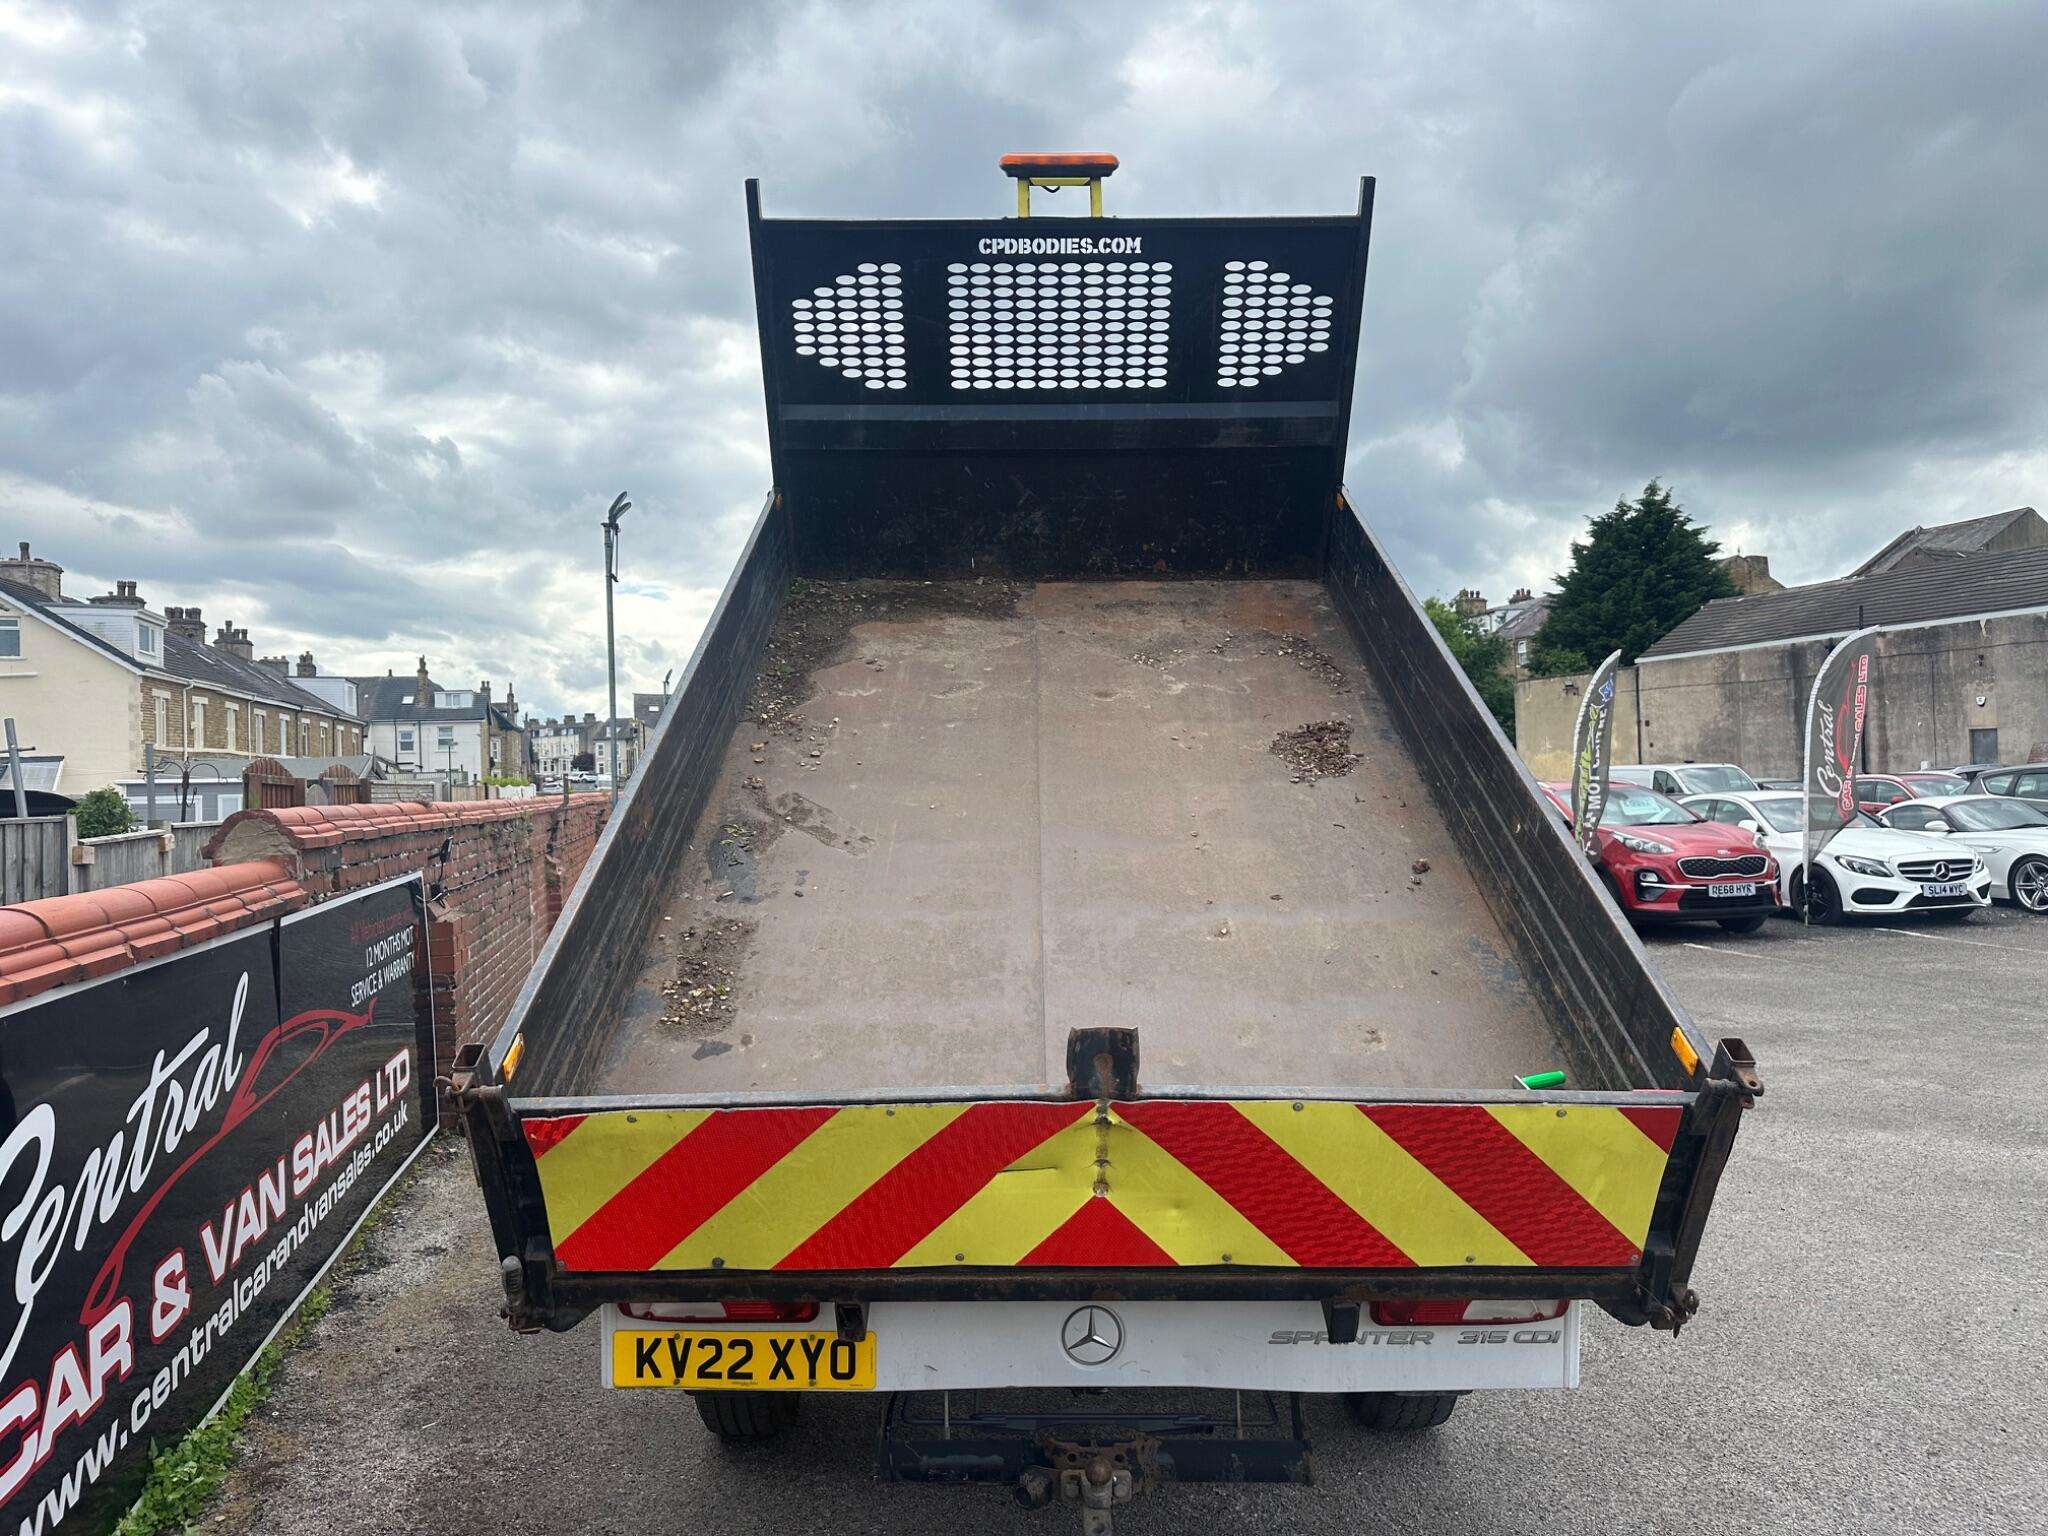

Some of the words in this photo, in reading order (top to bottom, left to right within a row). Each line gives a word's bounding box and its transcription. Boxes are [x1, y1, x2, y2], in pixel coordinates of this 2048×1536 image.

[977, 236, 1143, 255] CPDBODIES.COM
[1817, 699, 1843, 799] Central
[366, 946, 374, 969] 12
[373, 932, 401, 963] MONTHS
[400, 925, 414, 949] MOT
[350, 972, 378, 1008] SERVICE
[383, 951, 415, 986] WARRANTY
[0, 1301, 132, 1502] CAR
[151, 1252, 191, 1338] &
[200, 1158, 287, 1283] VAN
[293, 1082, 371, 1197] SALES
[375, 1048, 411, 1114] LTD
[636, 1337, 754, 1380] KV22
[1268, 1330, 1435, 1346] SPRNTER
[1457, 1330, 1509, 1345] 315
[1513, 1330, 1561, 1345] CDI
